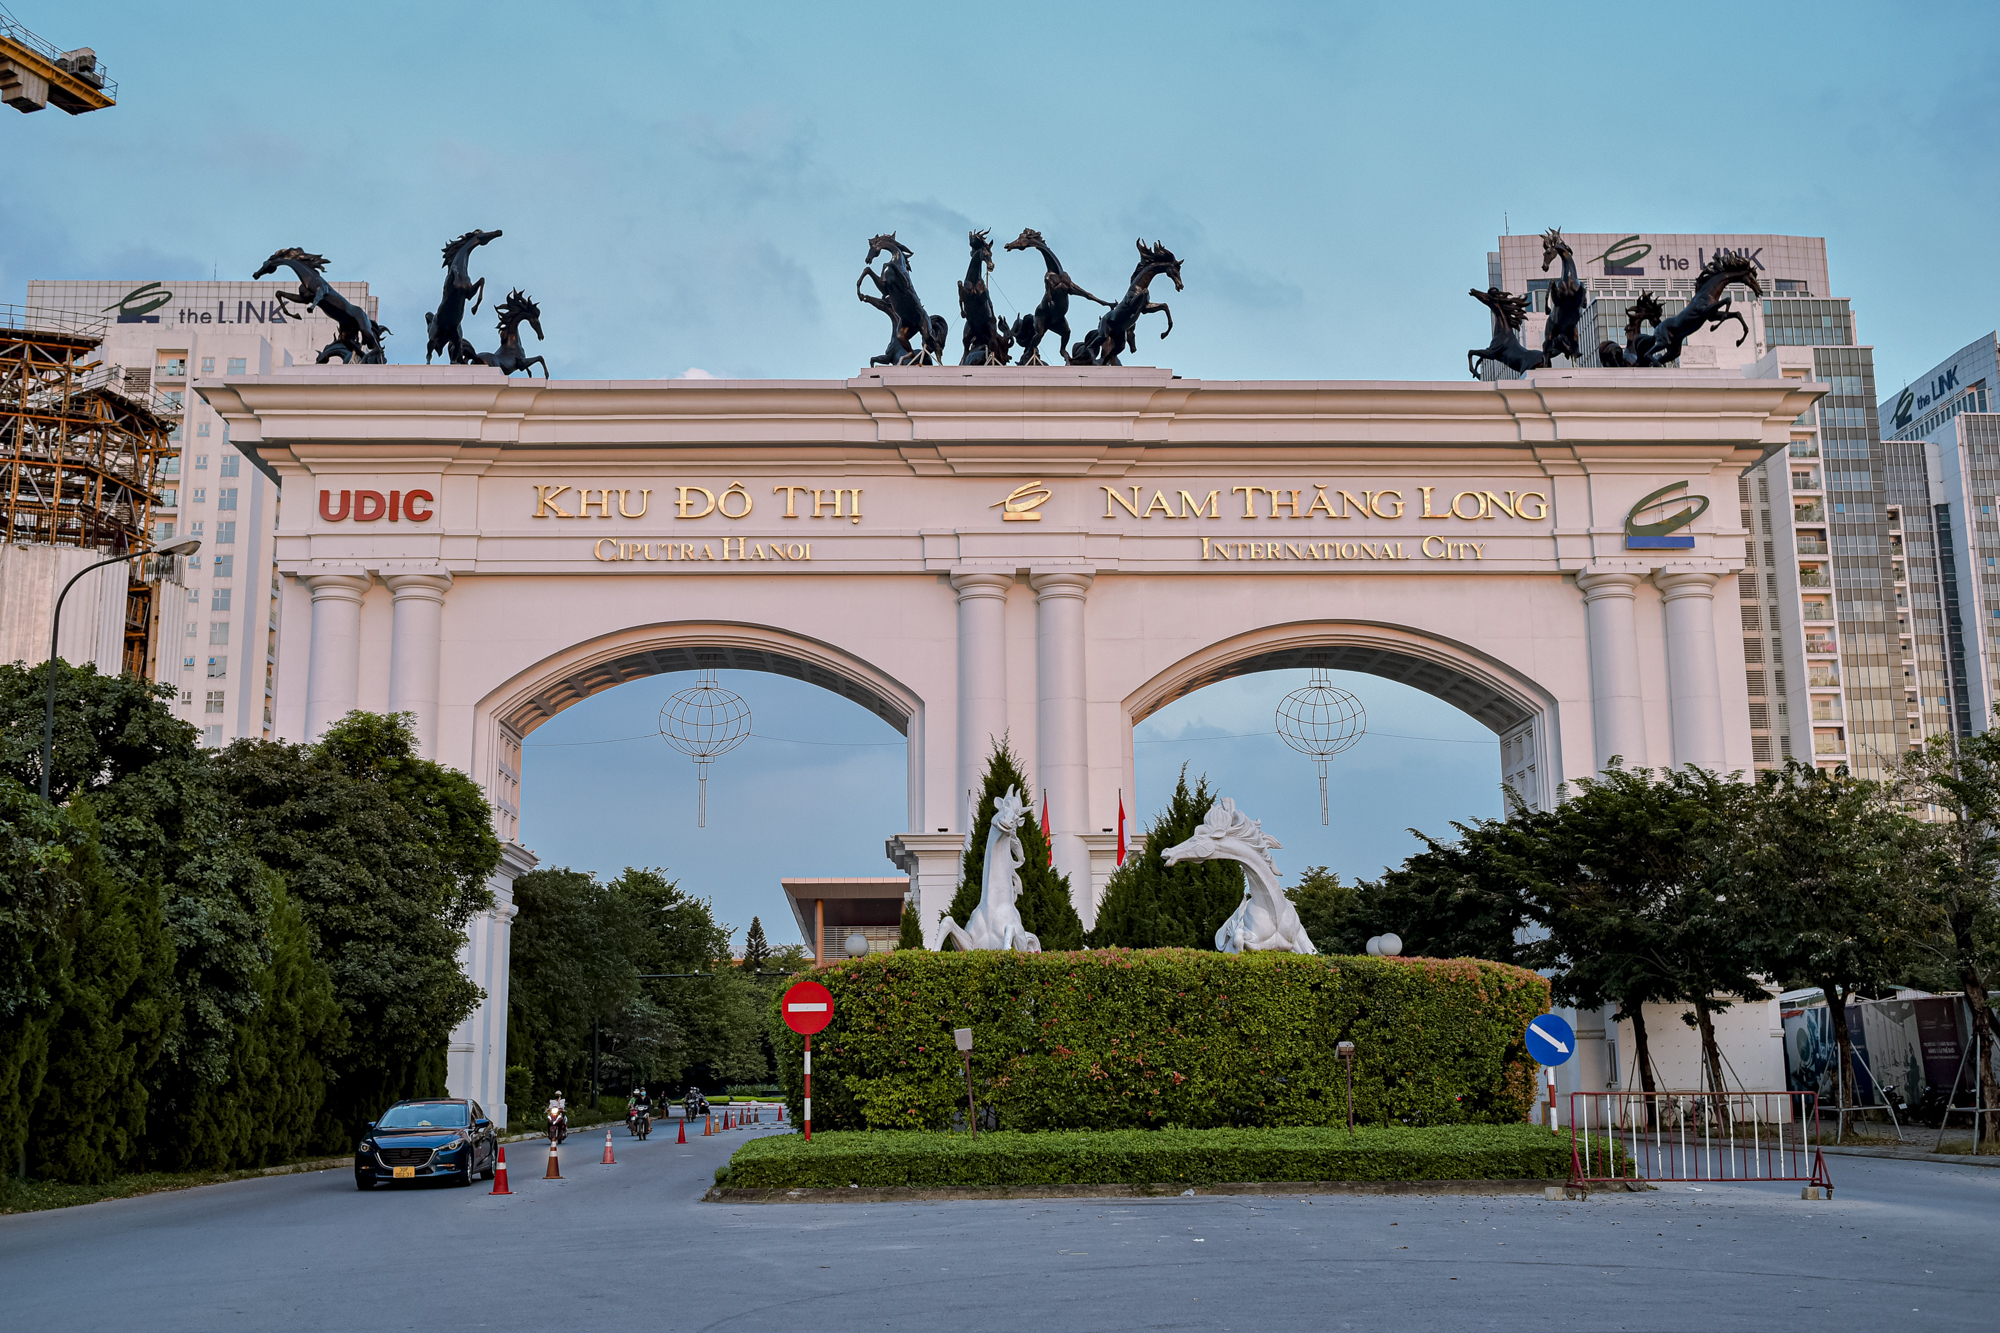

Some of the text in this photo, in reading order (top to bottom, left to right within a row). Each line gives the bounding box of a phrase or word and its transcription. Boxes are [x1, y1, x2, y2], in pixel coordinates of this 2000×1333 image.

[1659, 254, 1689, 270] the
[179, 300, 289, 324] the LINK
[1916, 364, 1960, 410] the LINK
[319, 489, 434, 522] UDIC
[532, 480, 863, 524] KHU ĐÔ THỊ
[1100, 483, 1550, 520] NAM THĂNG LONG
[594, 536, 812, 562] CIPUTRA HANOI
[1200, 535, 1487, 561] INTERNATIONAL CITY
